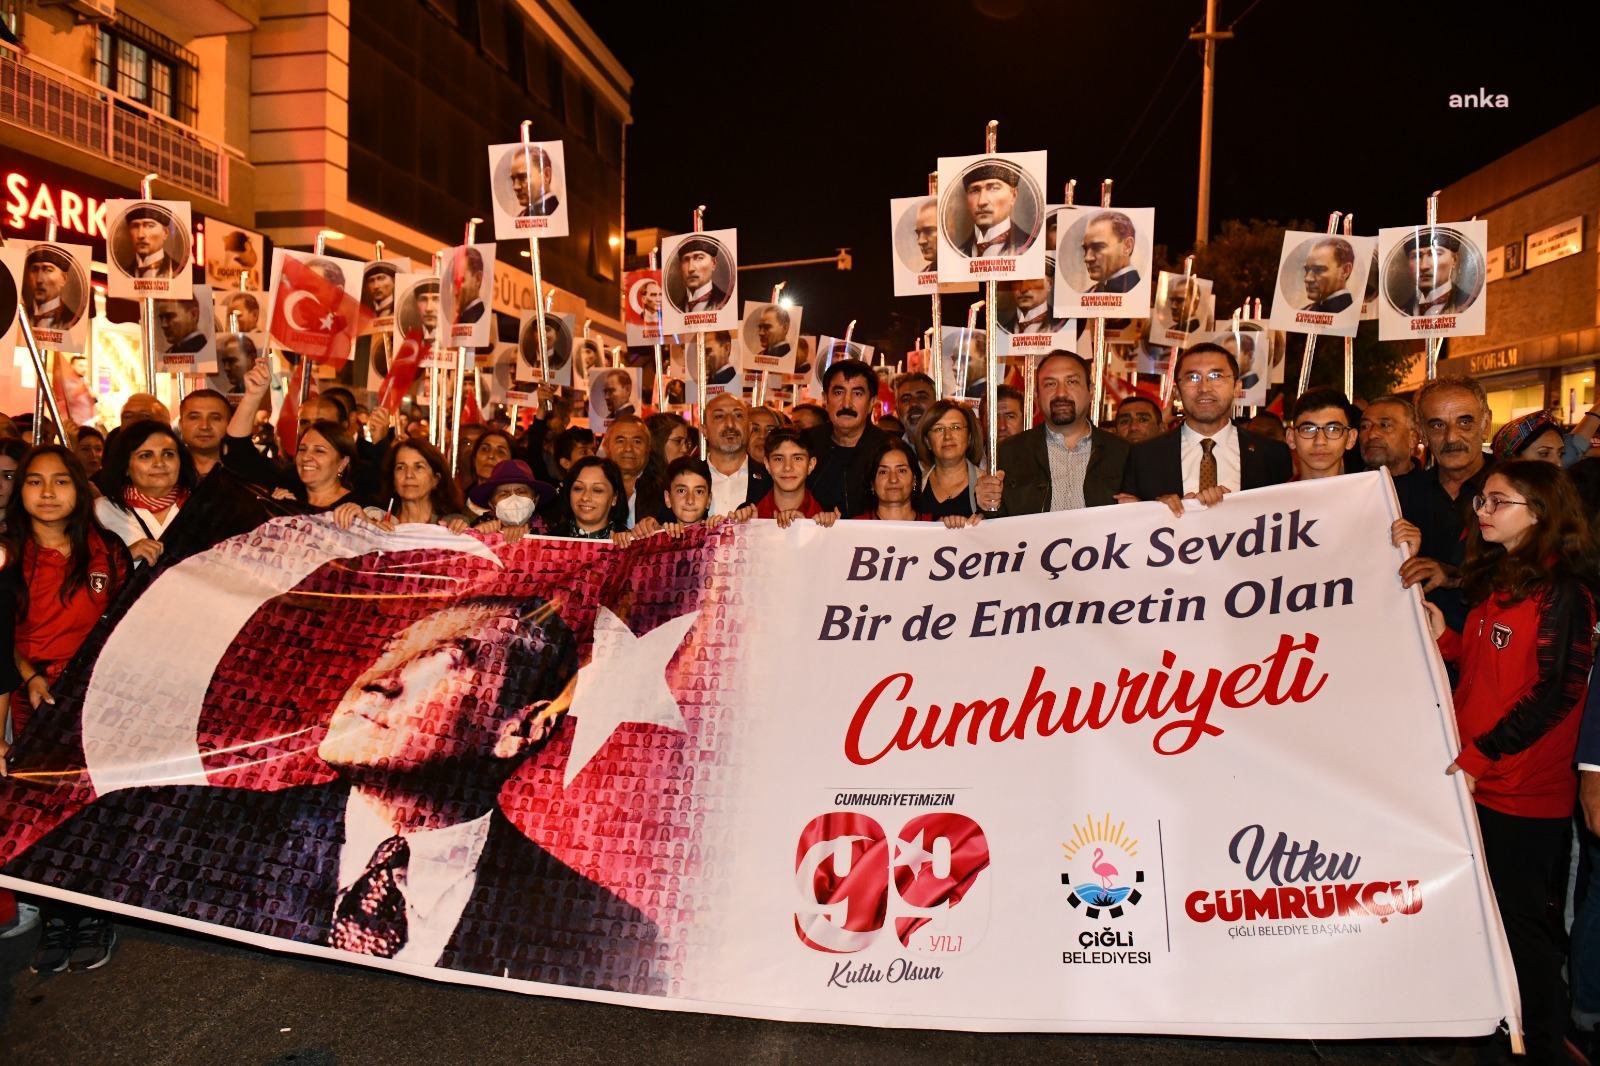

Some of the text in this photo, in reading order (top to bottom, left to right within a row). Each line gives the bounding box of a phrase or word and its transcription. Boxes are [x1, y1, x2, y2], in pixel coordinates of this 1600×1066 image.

[970, 258, 1016, 267] CUMHURİYET
[970, 264, 1016, 274] BAYRAMIMIZ
[684, 318, 717, 326] BAYRAMIMIZ
[1295, 317, 1333, 326] BAYRAMIMIZ
[1296, 312, 1334, 321] CUMHURİYET
[1411, 322, 1456, 331] BAYRAMIMIZ
[1012, 334, 1052, 342] CUMHURİYET
[1012, 339, 1052, 347] BAYRAMIMIZ
[846, 509, 1320, 581] Bir Seni Çok Sevdik
[818, 576, 1354, 642] Bir de Emanetin Olan
[844, 632, 1329, 766] Cumhuriyeti
[1228, 824, 1362, 887] Utku
[1184, 880, 1423, 924] GÜMRÜKÇÜ
[1228, 923, 1362, 939] ÇİĞLİ BELEDİYE BAŞKANI
[1078, 926, 1134, 949] ÇİĞLİ
[1062, 952, 1151, 964] BELEDİYESİ
[827, 957, 943, 989] Kutlu Olsun
